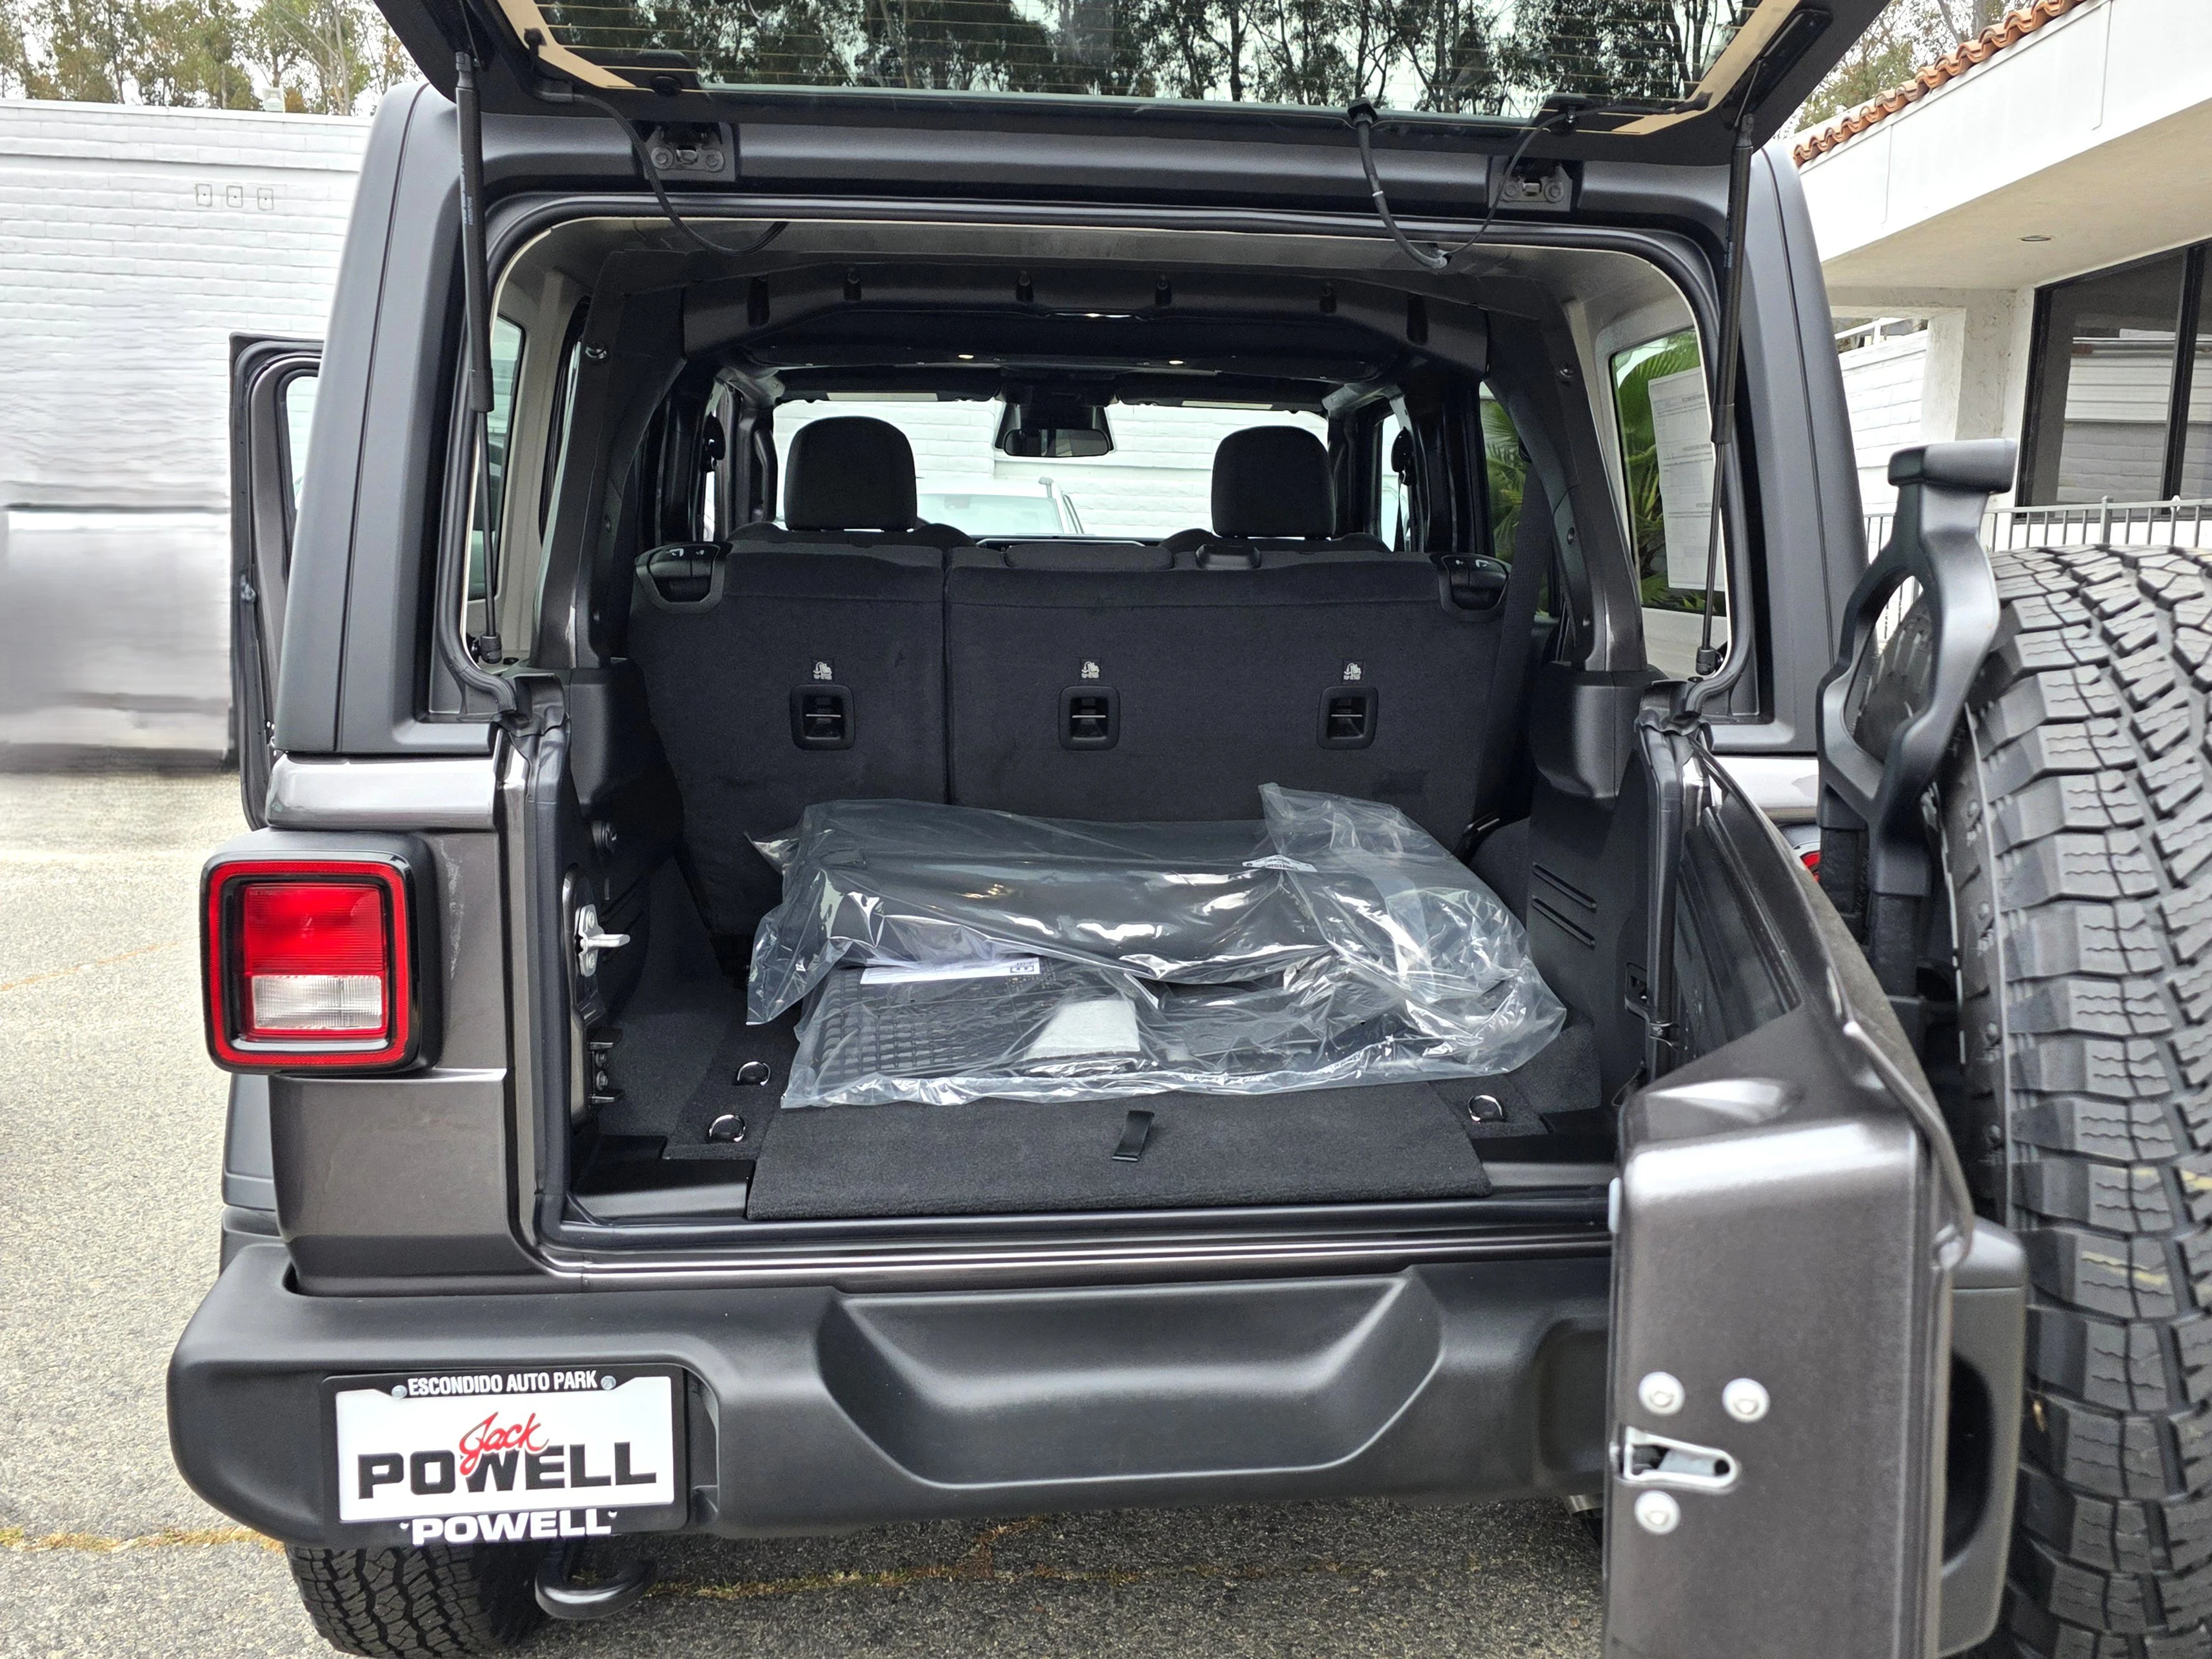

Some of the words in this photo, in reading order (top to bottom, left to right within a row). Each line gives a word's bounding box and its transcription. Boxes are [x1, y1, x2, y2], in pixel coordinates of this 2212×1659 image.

[408, 1374, 503, 1396] ESCONDIDO
[506, 1372, 548, 1392] AUTO
[553, 1371, 597, 1390] PARK
[459, 1412, 550, 1476] Jack
[358, 1442, 657, 1500] POWELL
[412, 1509, 612, 1545] POWELL
